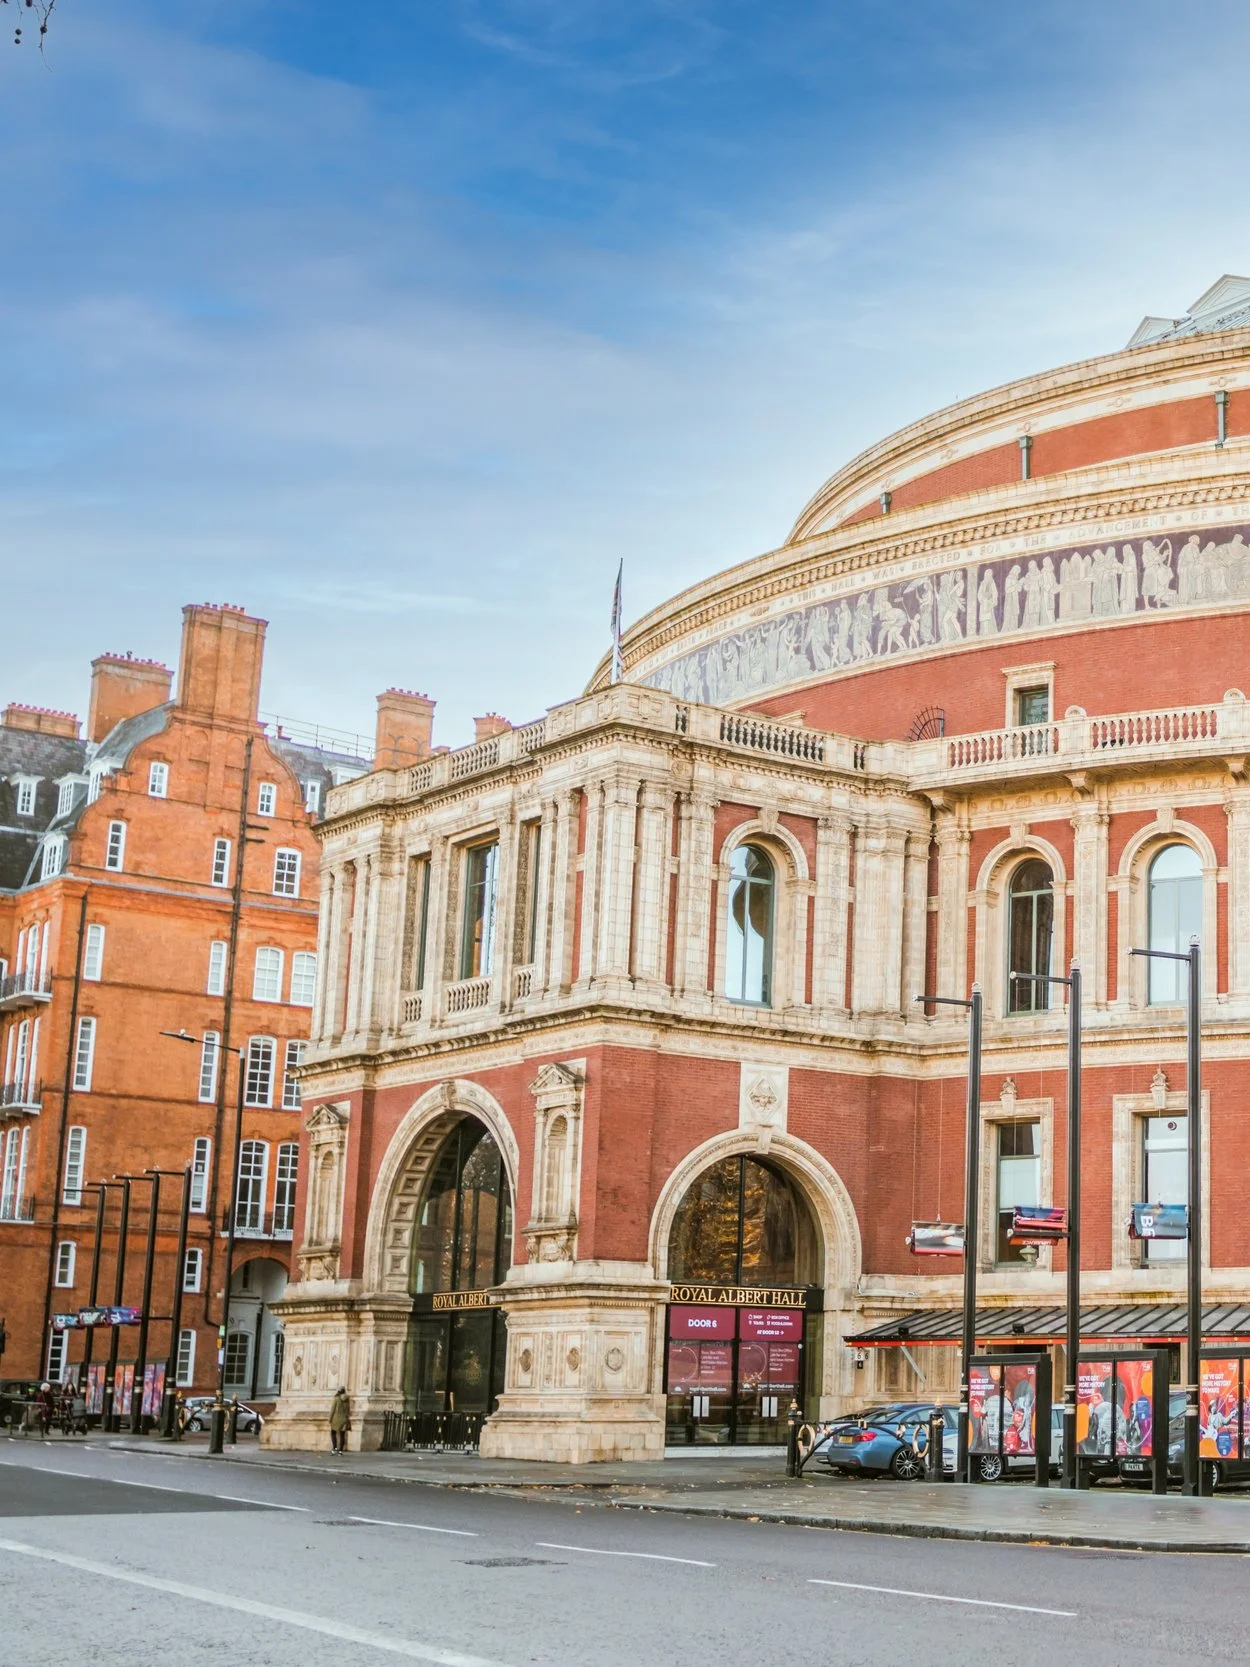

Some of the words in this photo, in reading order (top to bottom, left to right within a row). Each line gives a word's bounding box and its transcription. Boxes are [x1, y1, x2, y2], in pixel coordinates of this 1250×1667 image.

[911, 551, 961, 571] ERECTED
[980, 542, 1002, 556] FOR
[1024, 534, 1047, 548] THE
[1068, 515, 1168, 539] ADVANCEMENT
[1190, 510, 1208, 521] OF
[432, 1294, 458, 1309] ROYAL
[459, 1292, 487, 1307] ALBERT
[671, 1287, 717, 1302] ROYAL
[718, 1289, 770, 1304] ALBERT
[771, 1292, 807, 1306] HALL
[688, 1319, 712, 1328] DOOR
[712, 1320, 718, 1328] 6
